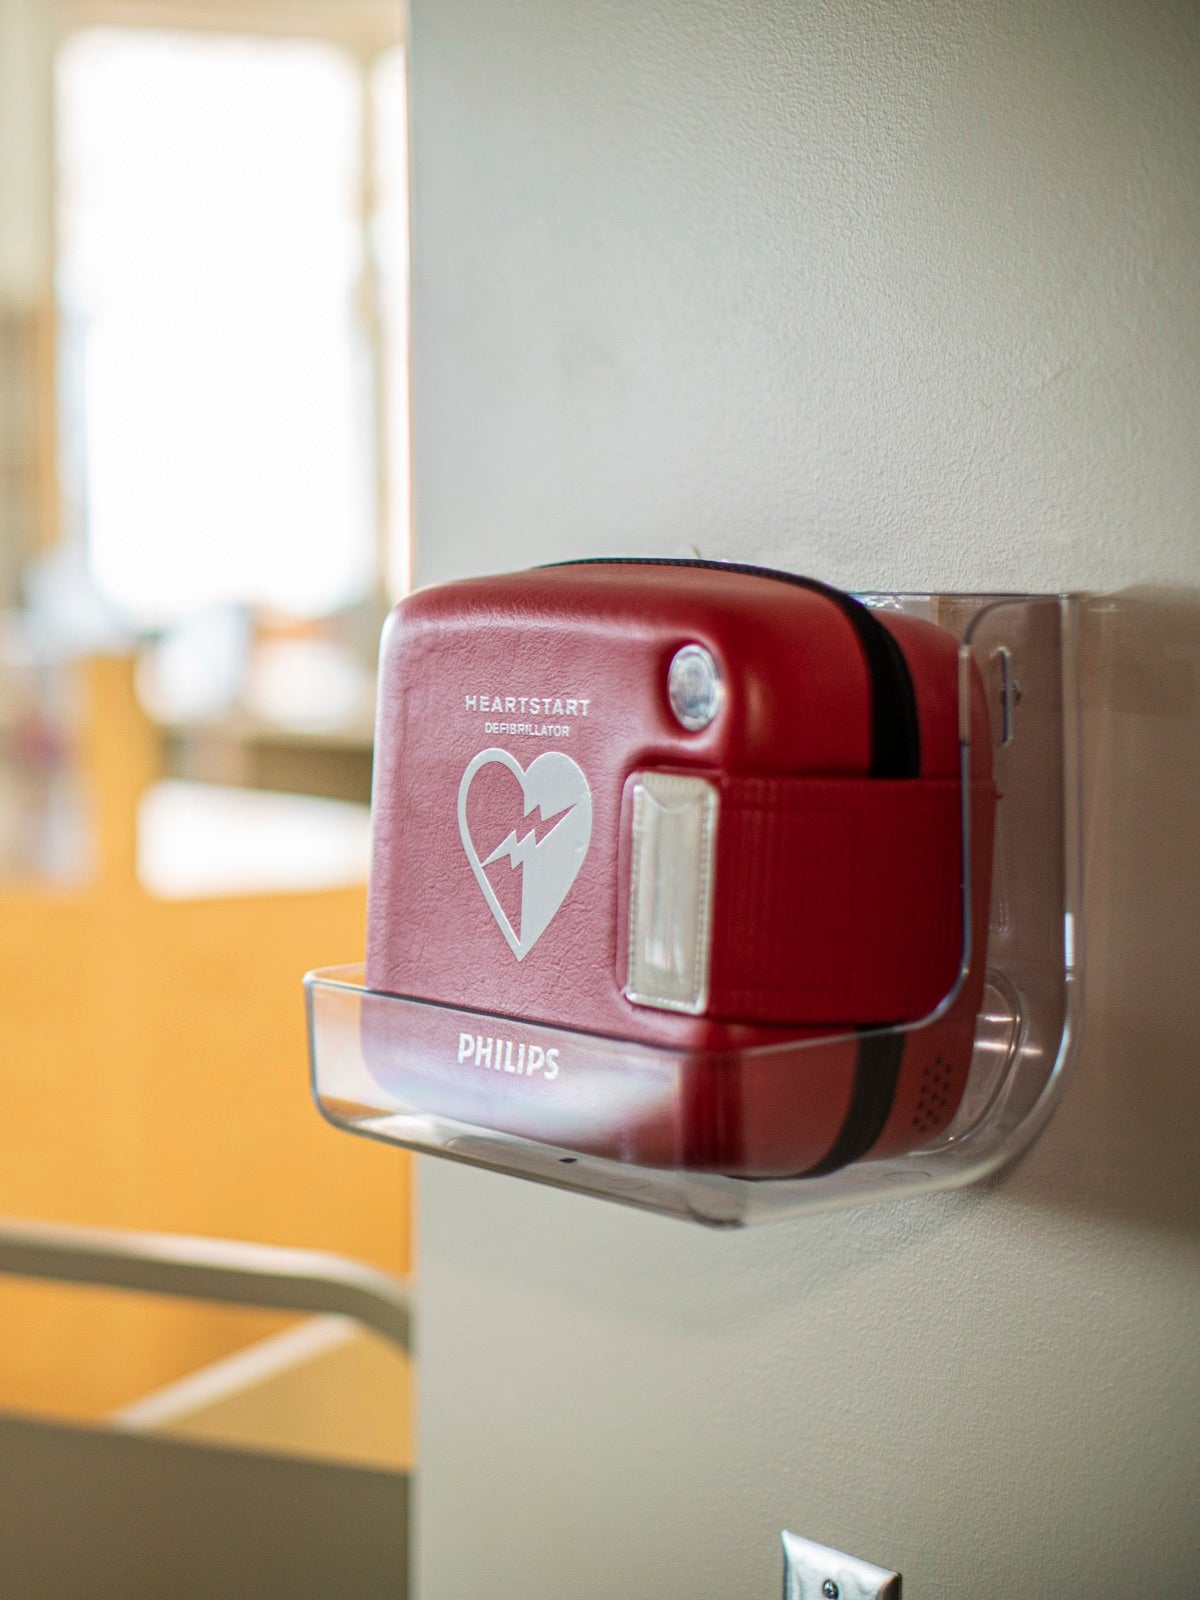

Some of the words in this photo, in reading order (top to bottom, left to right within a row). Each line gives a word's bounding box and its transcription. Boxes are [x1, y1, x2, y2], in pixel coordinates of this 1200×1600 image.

[464, 695, 591, 716] HEARTSTART
[484, 722, 570, 737] DEFIBRILLATOR
[457, 1032, 560, 1080] PHILIPS
